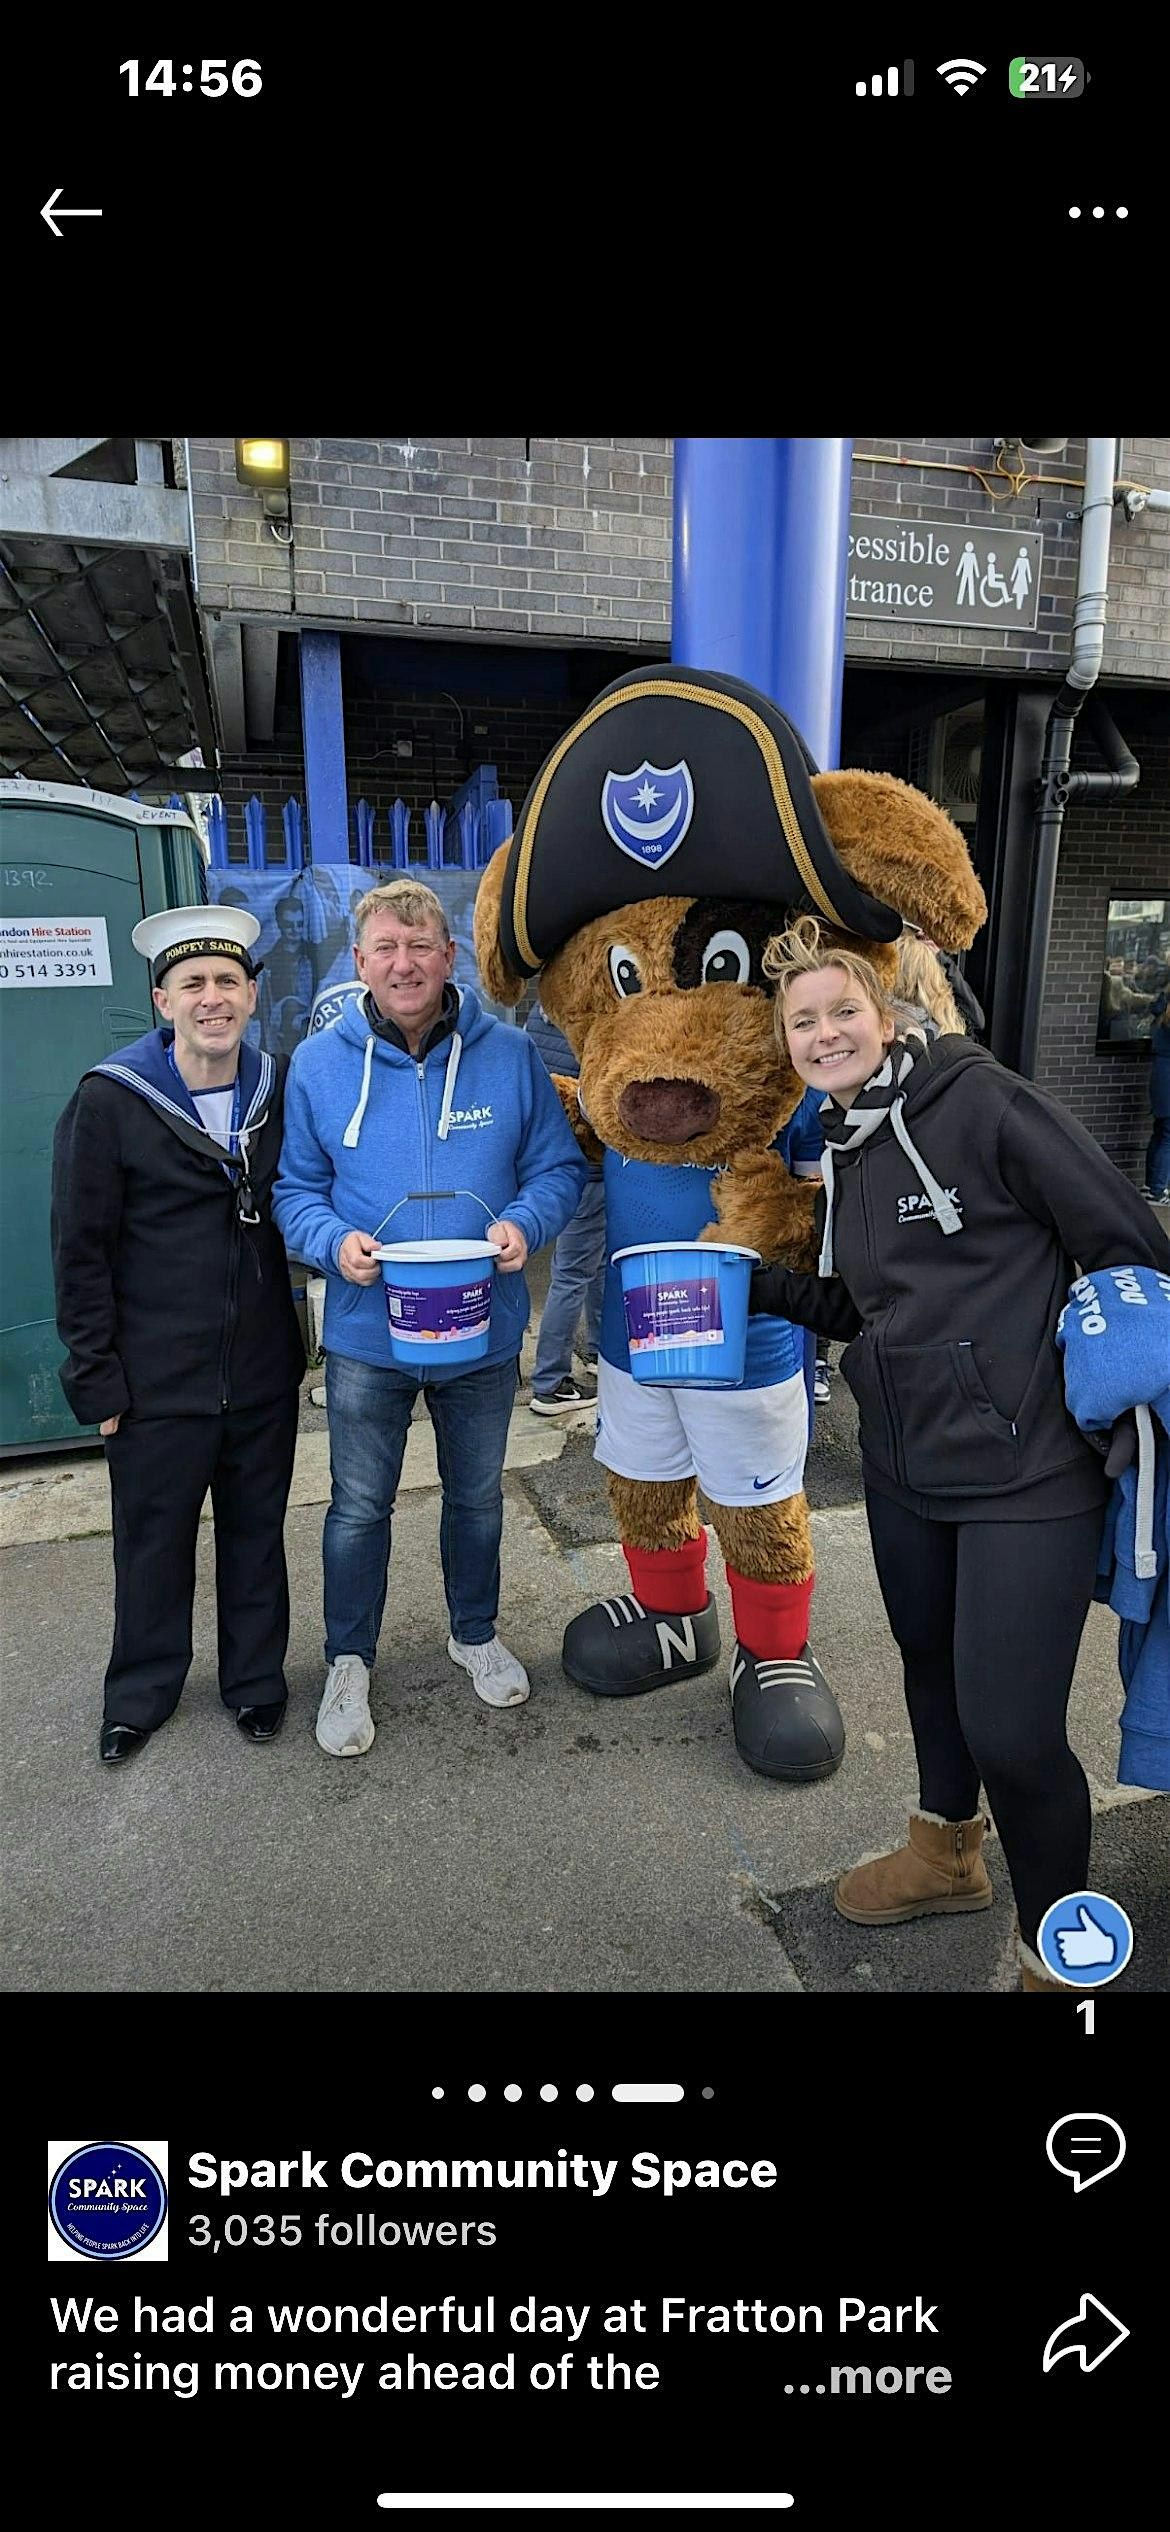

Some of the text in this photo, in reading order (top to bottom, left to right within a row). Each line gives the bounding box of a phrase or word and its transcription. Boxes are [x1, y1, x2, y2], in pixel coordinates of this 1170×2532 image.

[847, 573, 934, 607] trance
[142, 810, 177, 819] EVENT
[0, 926, 92, 937] ndon Hire Station
[166, 942, 242, 961] POMPEY SAILOR
[15, 964, 48, 978] 514
[54, 963, 96, 977] 3391
[312, 992, 358, 1033] ORT
[449, 1105, 493, 1124] SPARK
[897, 1187, 961, 1214] SPAK
[462, 1287, 484, 1300] SPARK
[657, 1289, 688, 1301] SPARK
[1110, 1268, 1149, 1305] YOU
